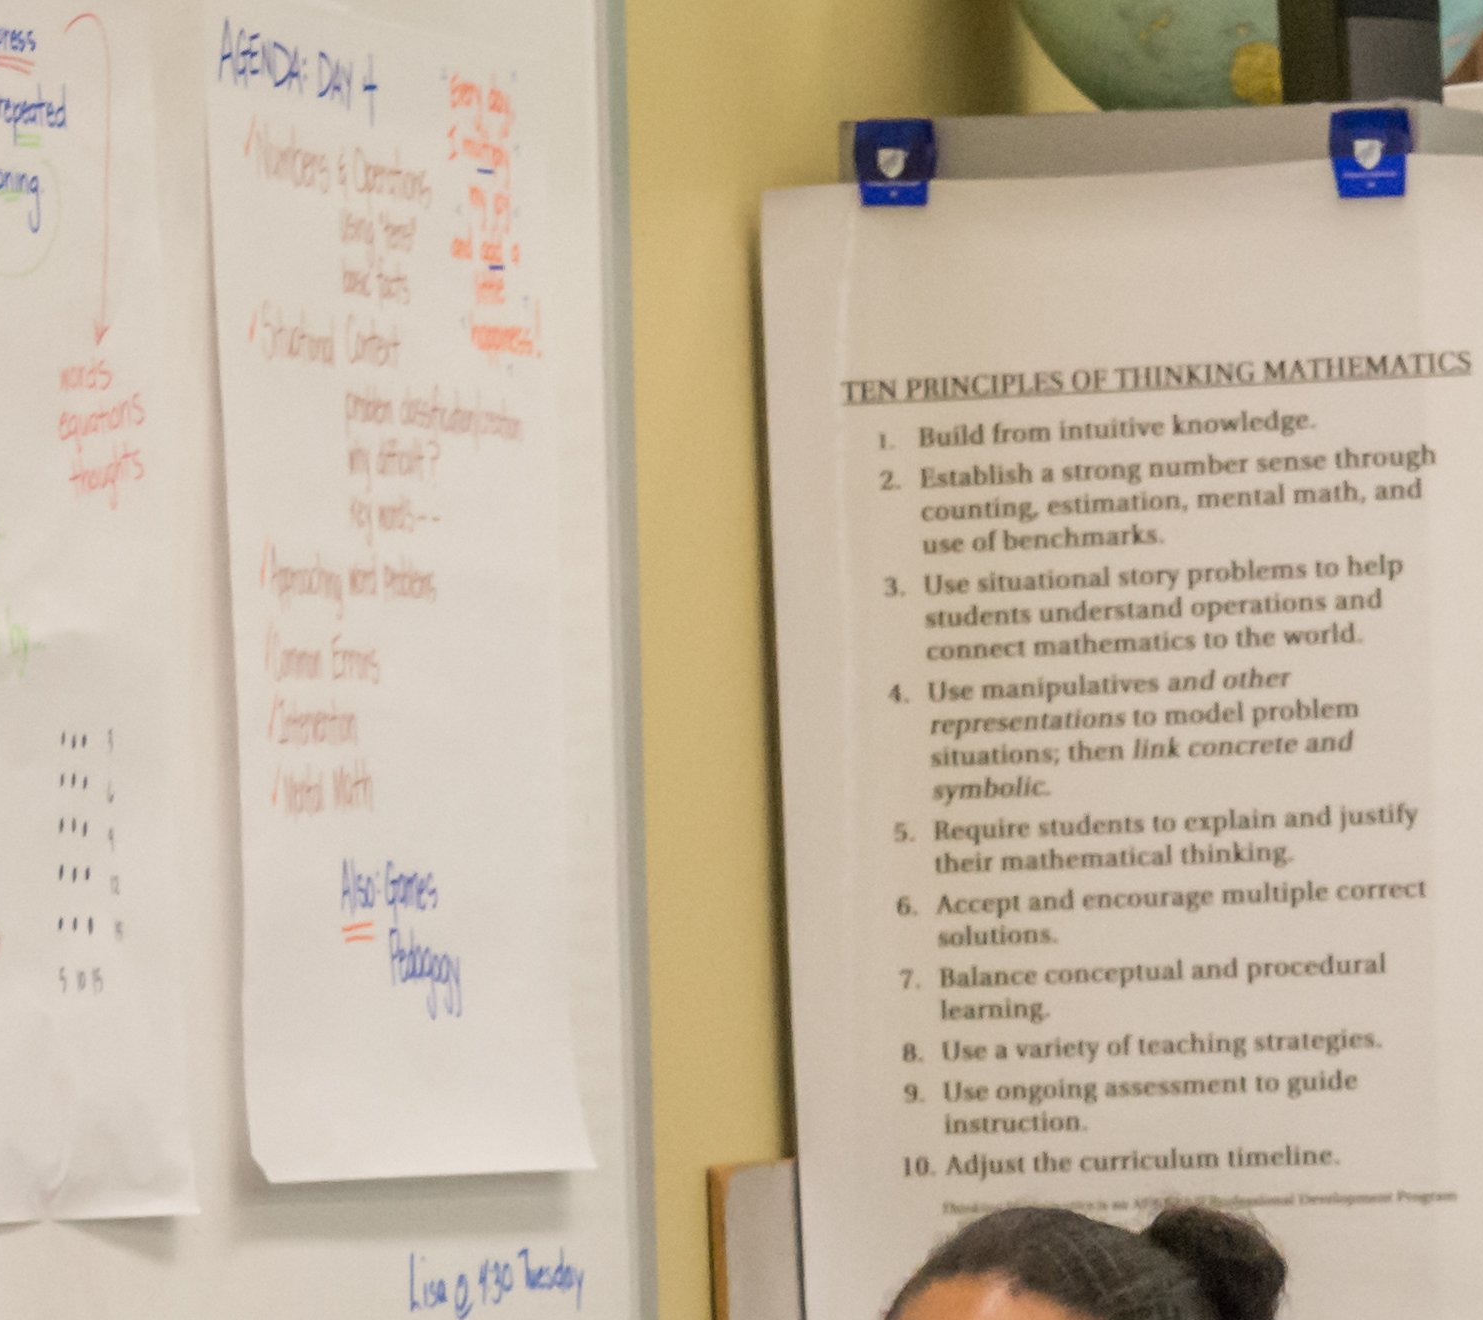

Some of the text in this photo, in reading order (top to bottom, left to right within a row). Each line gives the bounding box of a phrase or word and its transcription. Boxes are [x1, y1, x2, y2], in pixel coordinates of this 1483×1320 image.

[840, 350, 1473, 400] TEN PRINCIPLES OF THINKING MATHEMATICS
[918, 408, 1316, 449] Build from intuitive knowledge.
[920, 443, 1437, 489] Establish a strong number sense through
[920, 476, 1423, 524] counting, estimation, mental math, and
[922, 523, 1165, 555] use of benchmarks.
[923, 553, 1404, 596] Use situational story problems to help
[903, 1143, 1340, 1182] 10. Adjust the curriculum timeline.
